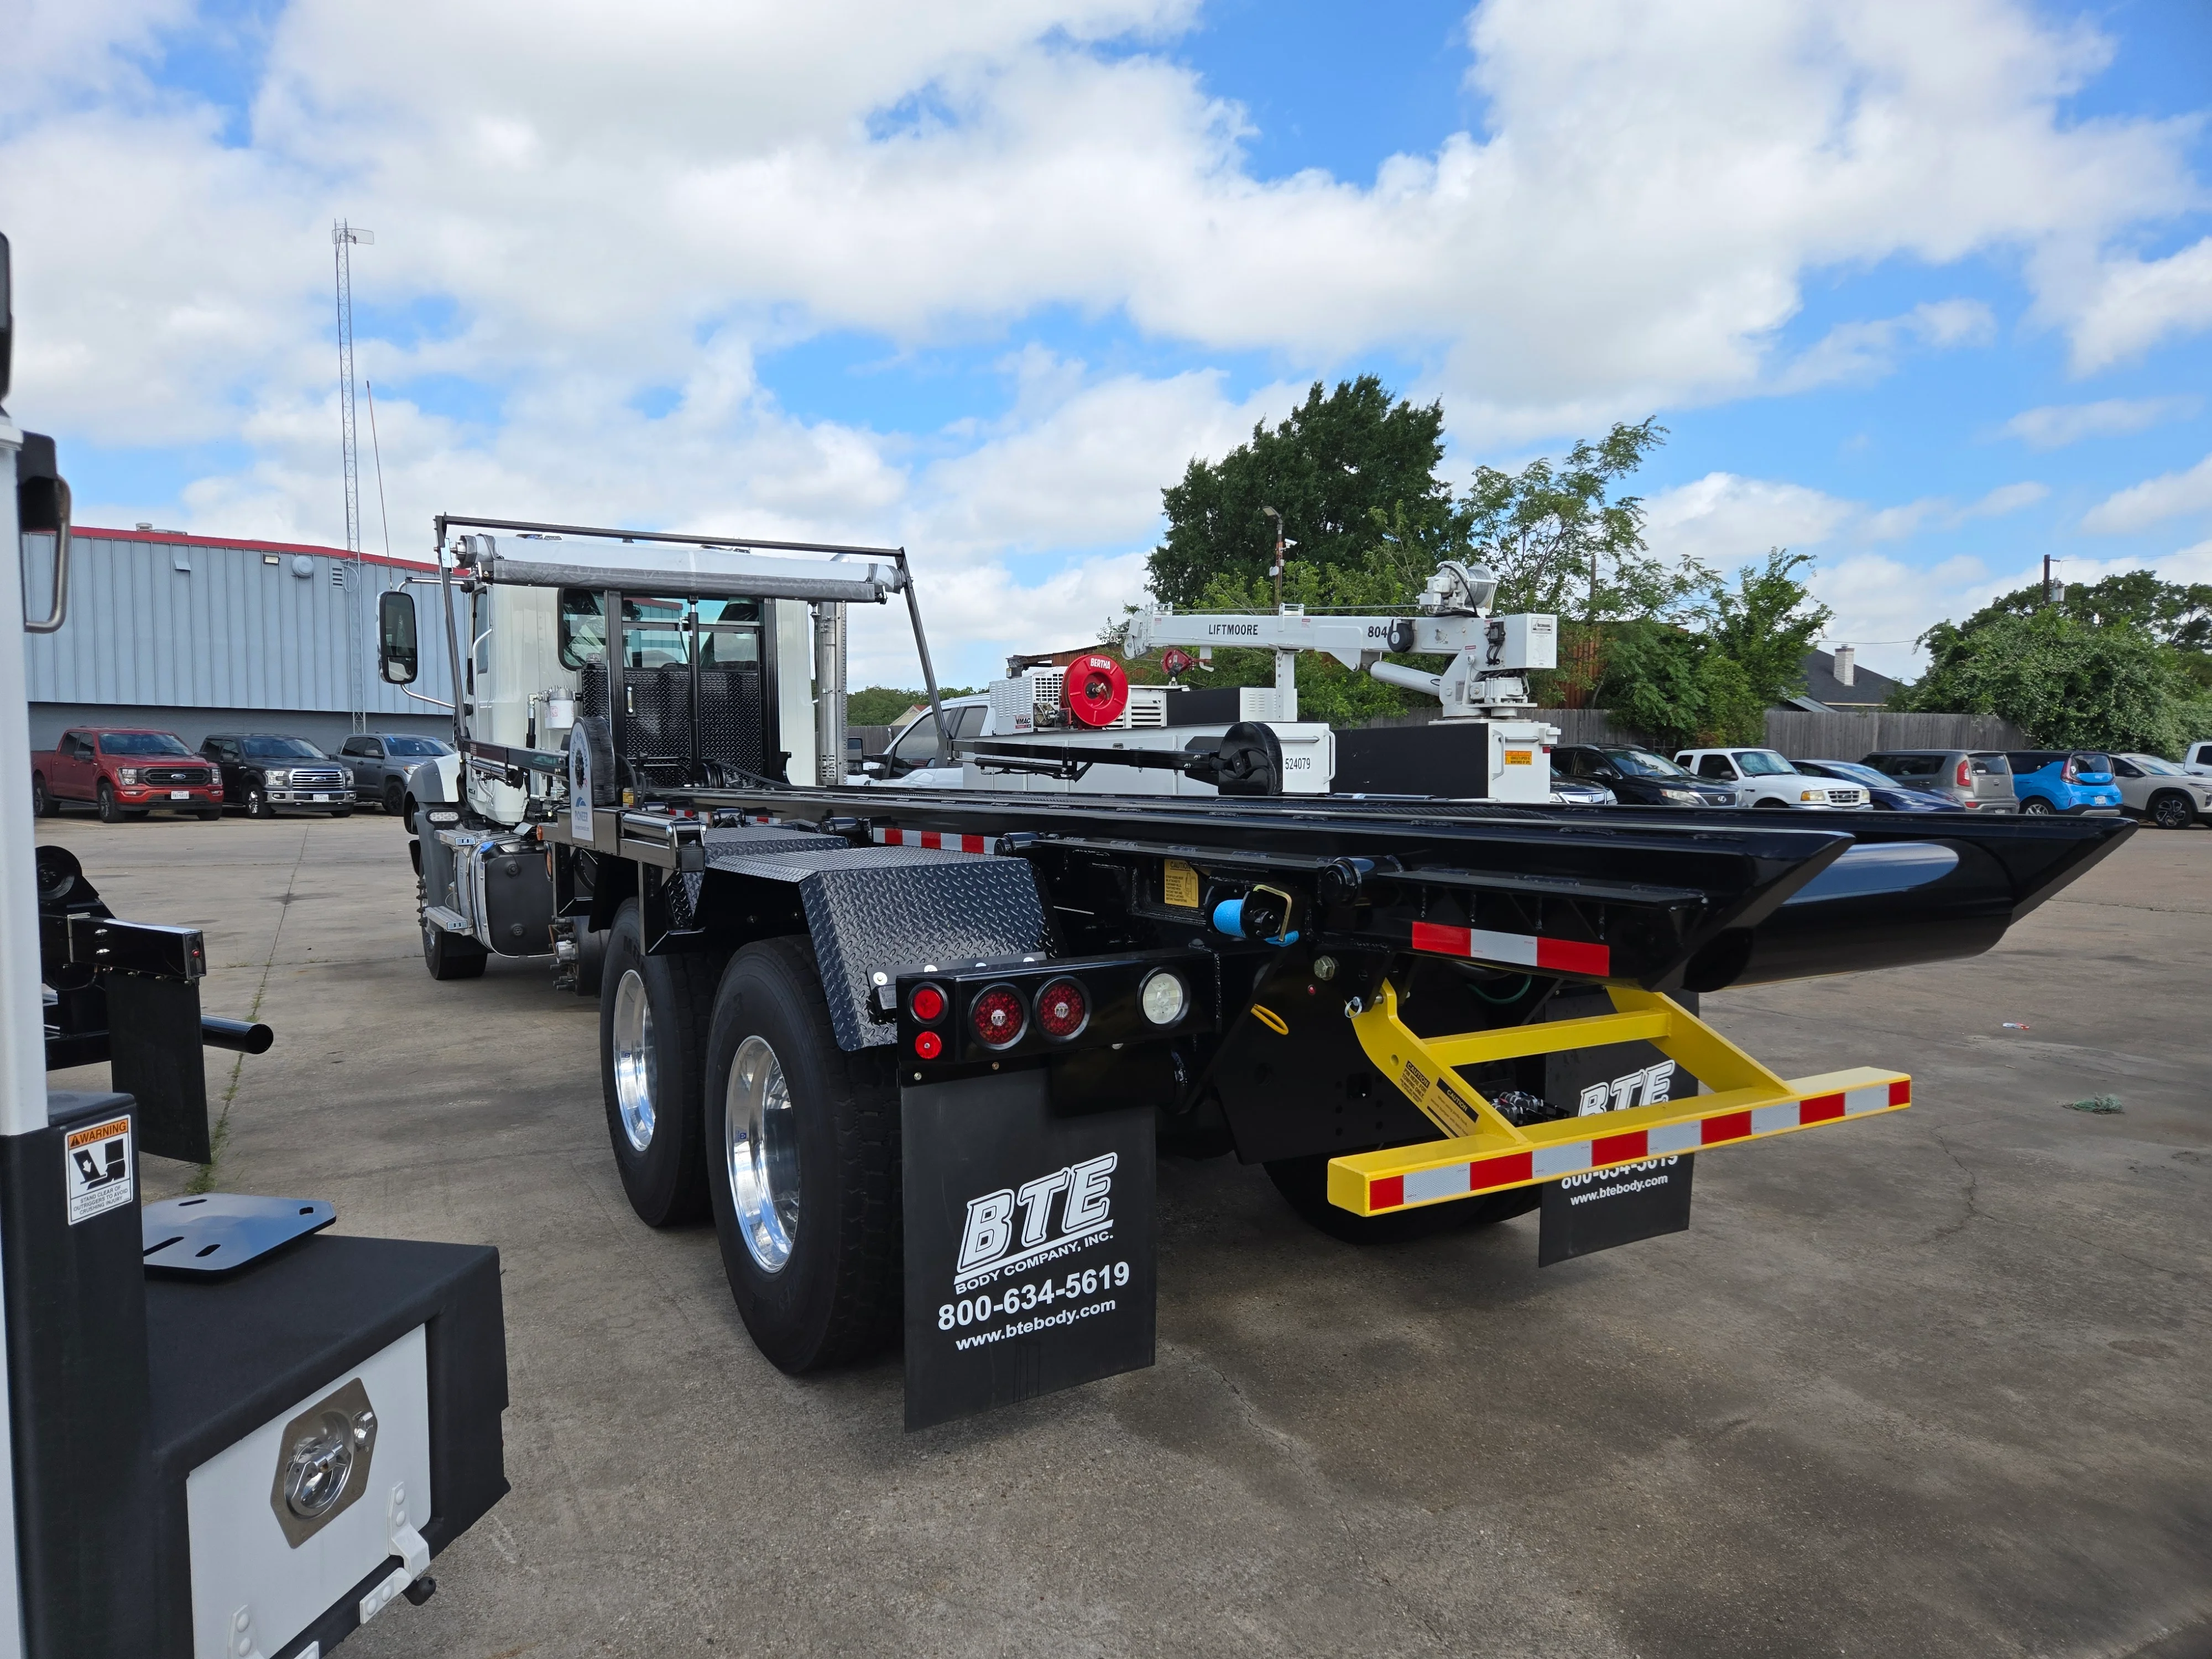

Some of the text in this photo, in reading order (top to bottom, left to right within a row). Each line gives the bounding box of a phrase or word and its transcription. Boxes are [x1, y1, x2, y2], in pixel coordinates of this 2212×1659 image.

[1209, 624, 1258, 635] LIFTMOORE
[1368, 625, 1387, 638] 804
[1090, 658, 1110, 670] BERTHA
[1015, 716, 1031, 724] VMAC
[1285, 758, 1311, 769] 524079
[575, 810, 588, 822] PIONEER
[1170, 861, 1191, 870] CAUTION
[1402, 1073, 1416, 1089] TOWING
[1407, 1063, 1429, 1086] CAUTION
[1410, 1074, 1420, 1086] HERE
[1578, 1060, 1675, 1117] BTE
[1447, 1089, 1468, 1112] CAUTION
[79, 1121, 127, 1143] WARNING
[80, 1194, 96, 1203] STAND
[97, 1188, 113, 1197] CLEAR
[1571, 1175, 1668, 1205] www.btebody.com
[74, 1196, 105, 1212] OUTRIGGERS
[113, 1188, 128, 1197] AVOID
[80, 1196, 123, 1214] CRUSHING INJURY
[957, 1152, 1118, 1273] BTE
[956, 1231, 1114, 1295] BODY COMPANY, INC.
[938, 1261, 1129, 1330] 800-634-5619
[956, 1300, 1116, 1350] www.btebody.com
